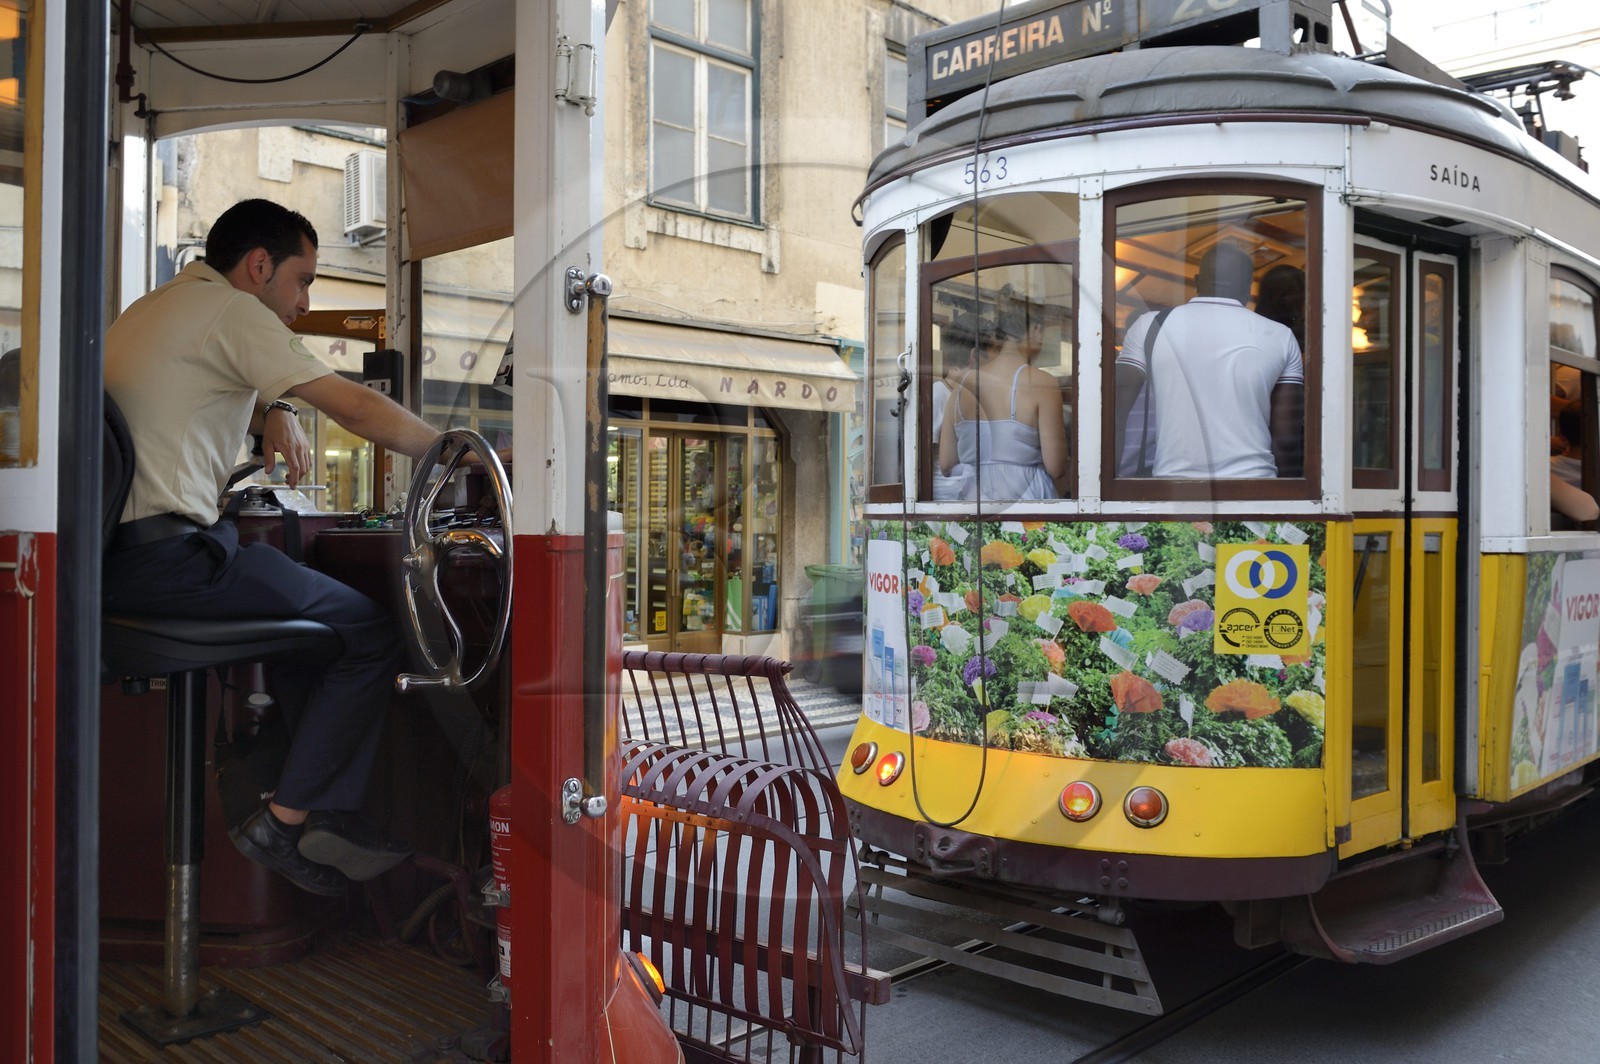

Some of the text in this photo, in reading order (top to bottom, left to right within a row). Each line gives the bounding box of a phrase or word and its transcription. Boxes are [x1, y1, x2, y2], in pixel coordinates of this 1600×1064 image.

[932, 15, 1064, 80] CARREIRA
[964, 156, 1007, 185] 563
[1430, 164, 1481, 192] SAÍDA
[719, 376, 838, 402] NARDO
[869, 572, 899, 594] VIGOR
[1566, 593, 1600, 622] VIGOR
[1226, 623, 1255, 634] apcer
